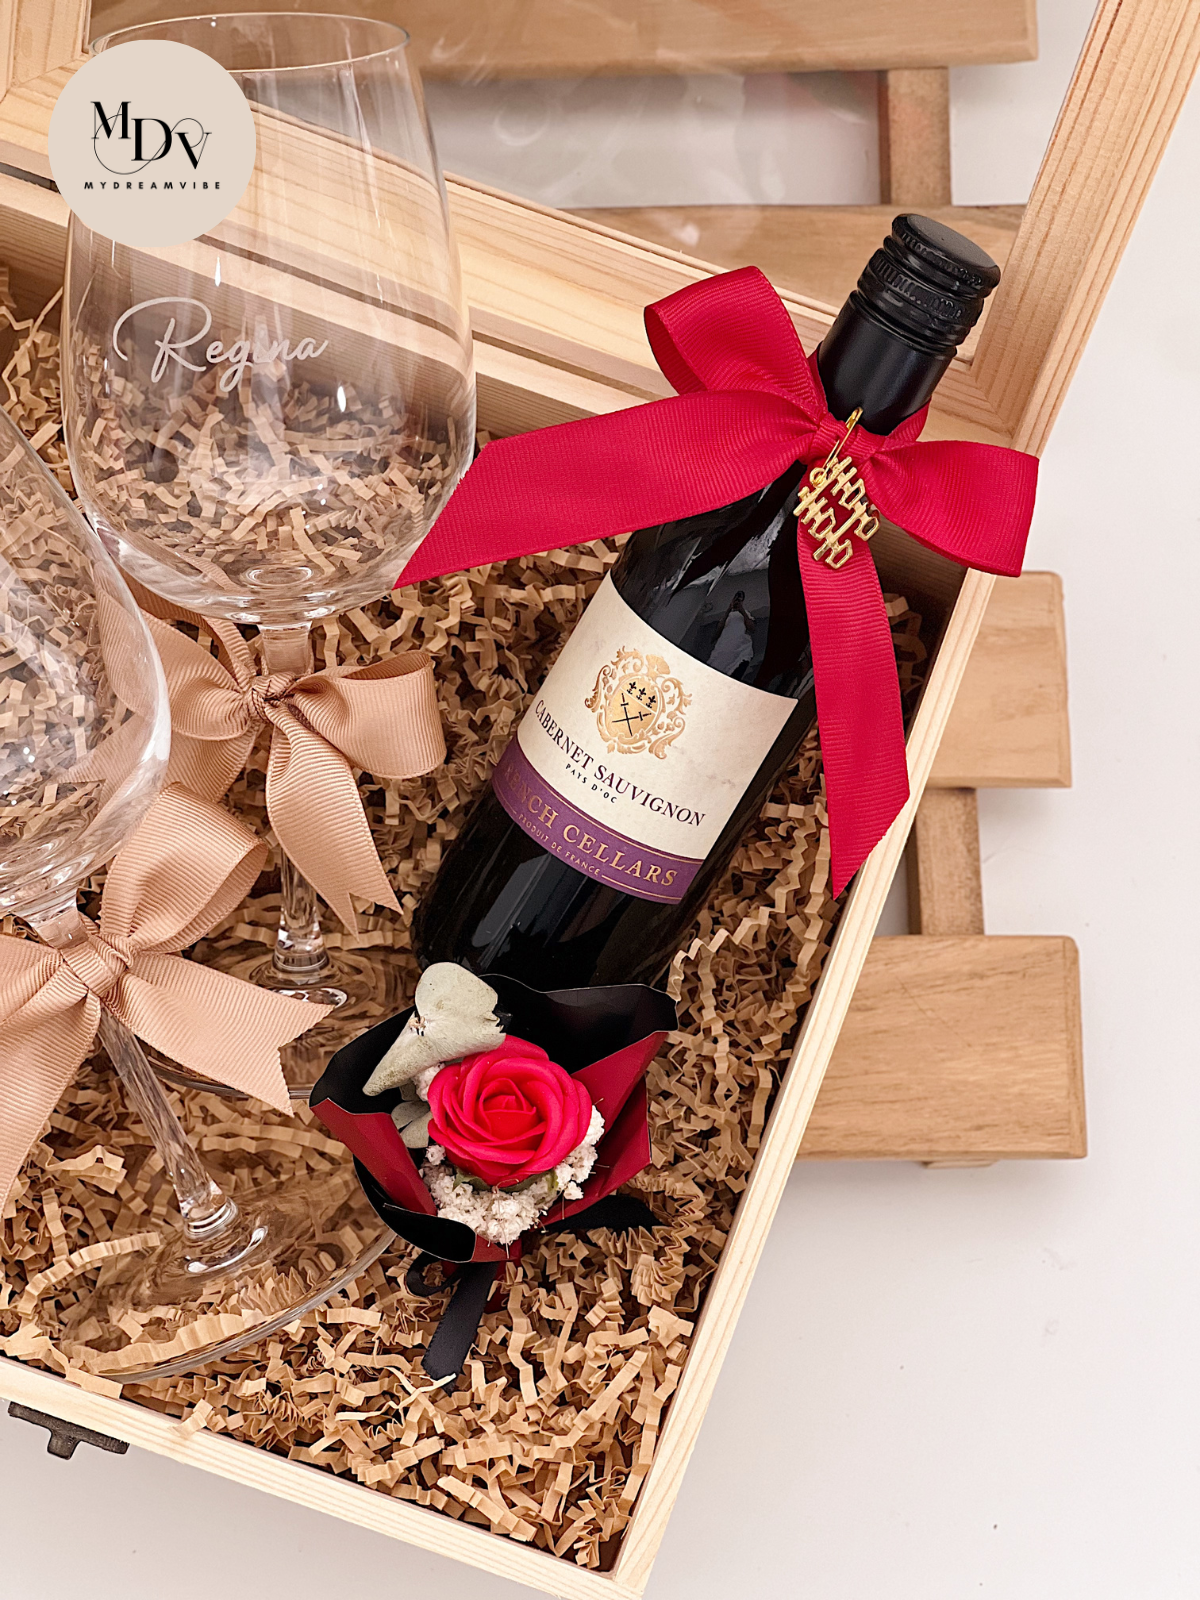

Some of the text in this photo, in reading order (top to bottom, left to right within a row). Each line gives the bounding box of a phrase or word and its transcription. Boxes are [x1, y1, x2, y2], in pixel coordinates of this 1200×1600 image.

[112, 296, 329, 393] Regina
[534, 699, 707, 827] CABERNET SAUVIGNON
[565, 763, 618, 804] PAYS D'OC
[518, 813, 601, 877] PRODUIT DE FRANCE
[562, 824, 678, 886] CELLARS
